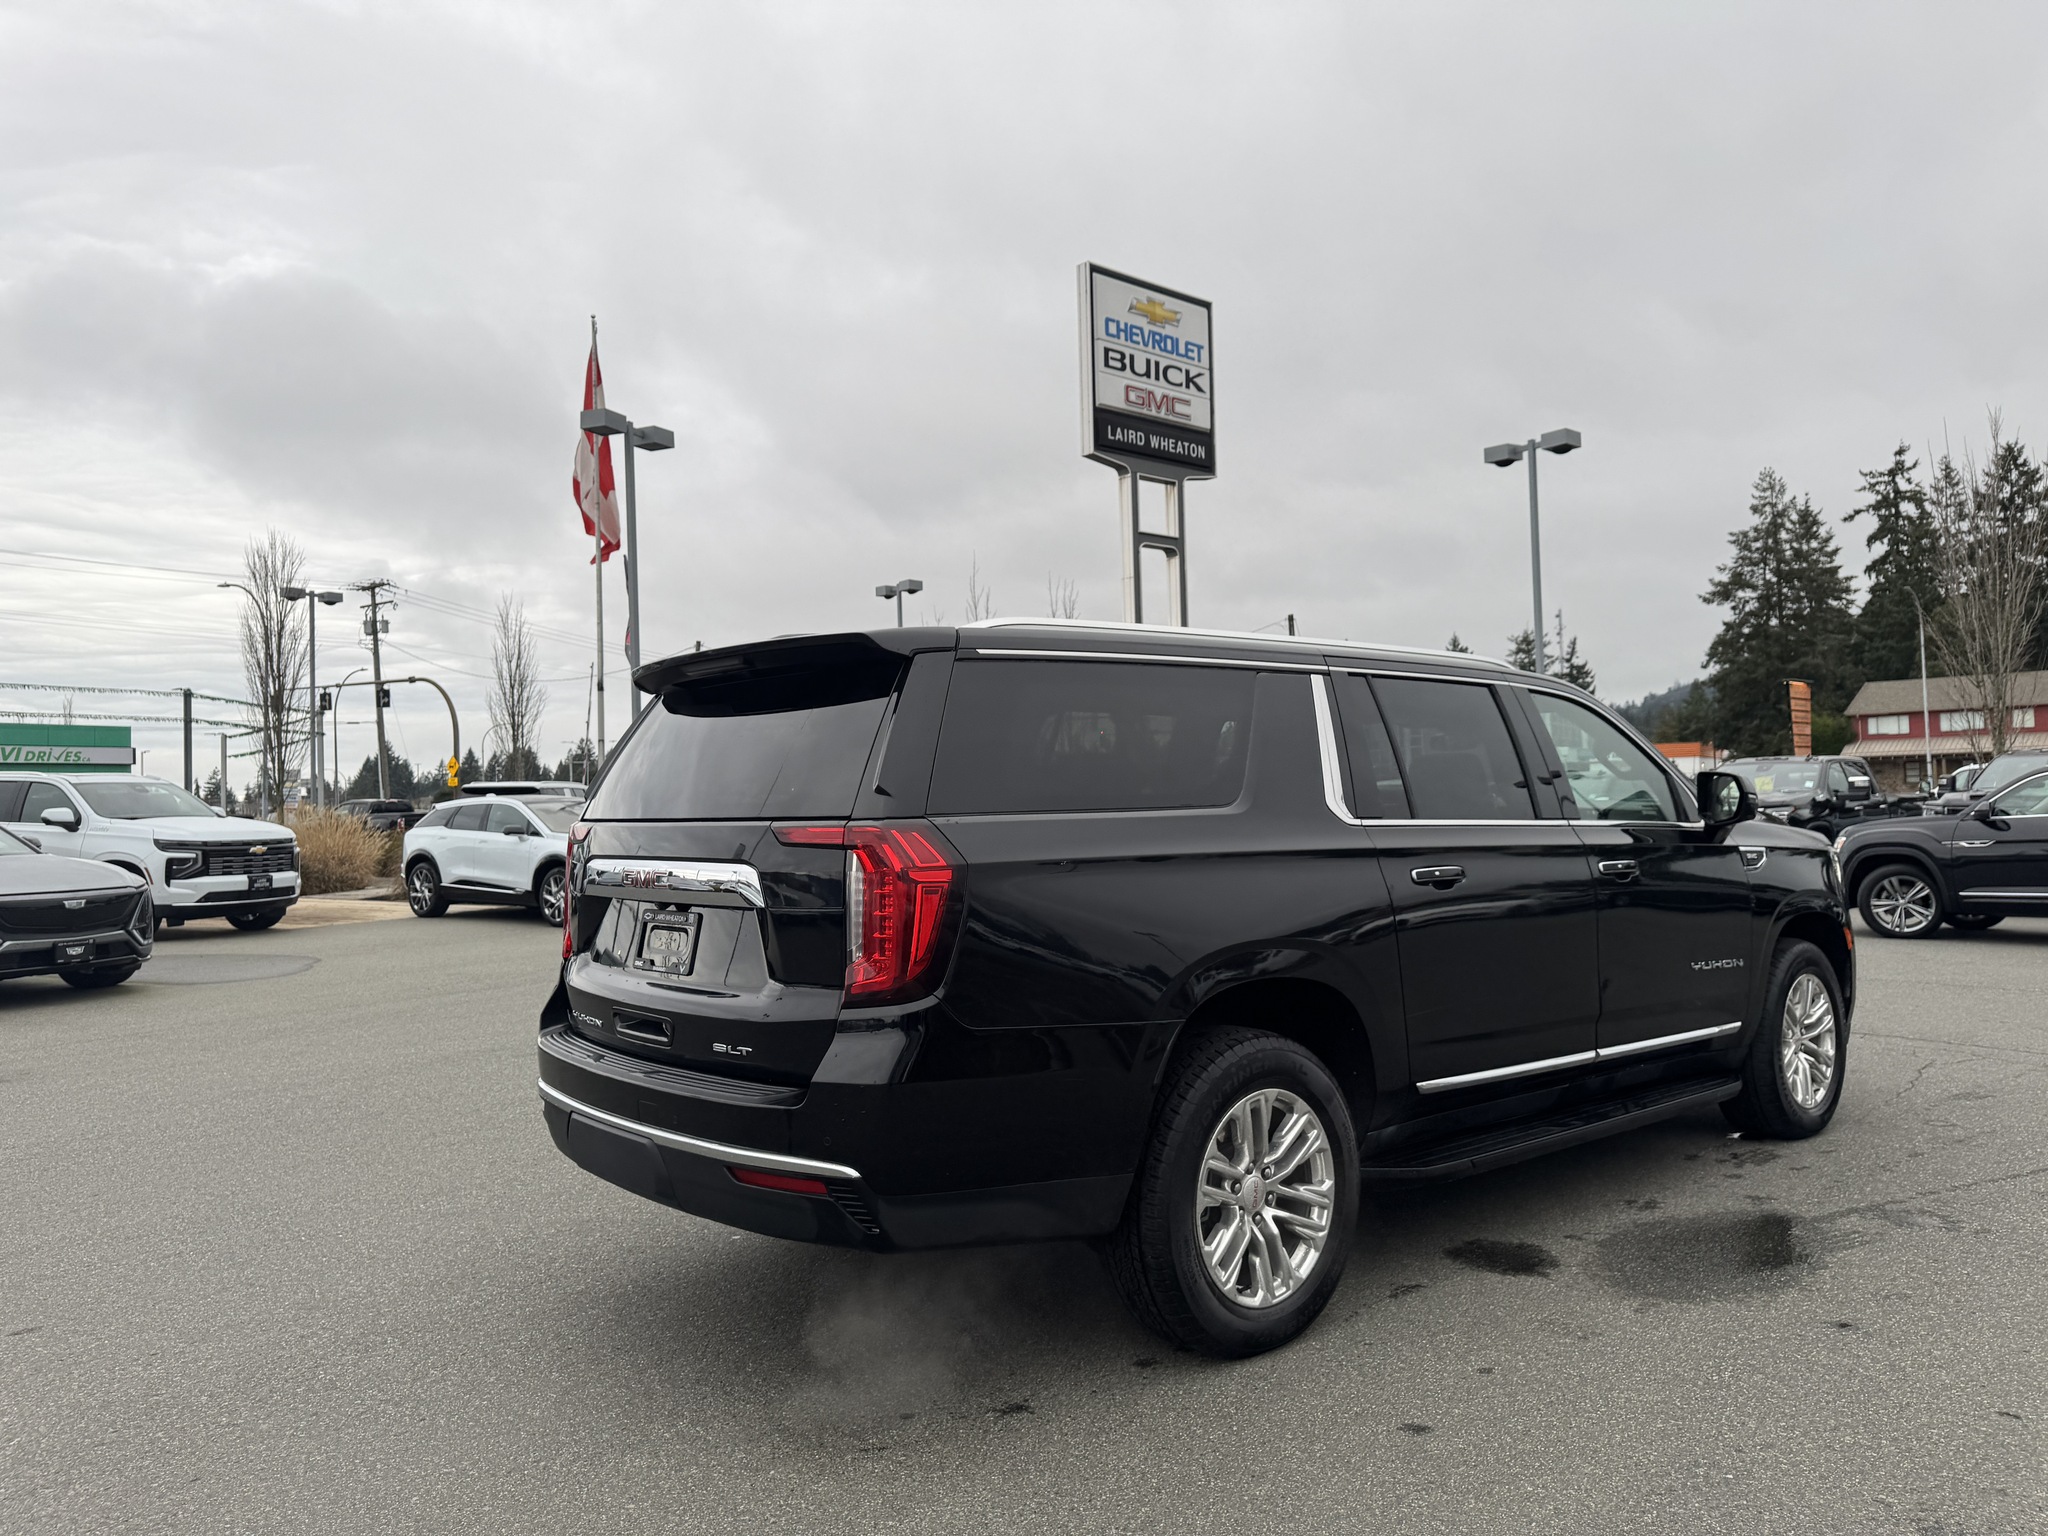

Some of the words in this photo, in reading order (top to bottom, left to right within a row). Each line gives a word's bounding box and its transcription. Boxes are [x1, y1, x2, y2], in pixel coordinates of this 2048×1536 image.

[1104, 316, 1204, 363] CHEVROLET
[1103, 346, 1206, 394] BUICK
[1124, 383, 1191, 422] GMC
[1107, 425, 1145, 446] LAIRD
[1149, 434, 1205, 459] WHEATON
[622, 869, 668, 889] GMC
[1691, 958, 1744, 970] YUKON
[572, 1009, 603, 1027] YUKON
[712, 1043, 752, 1056] SLT
